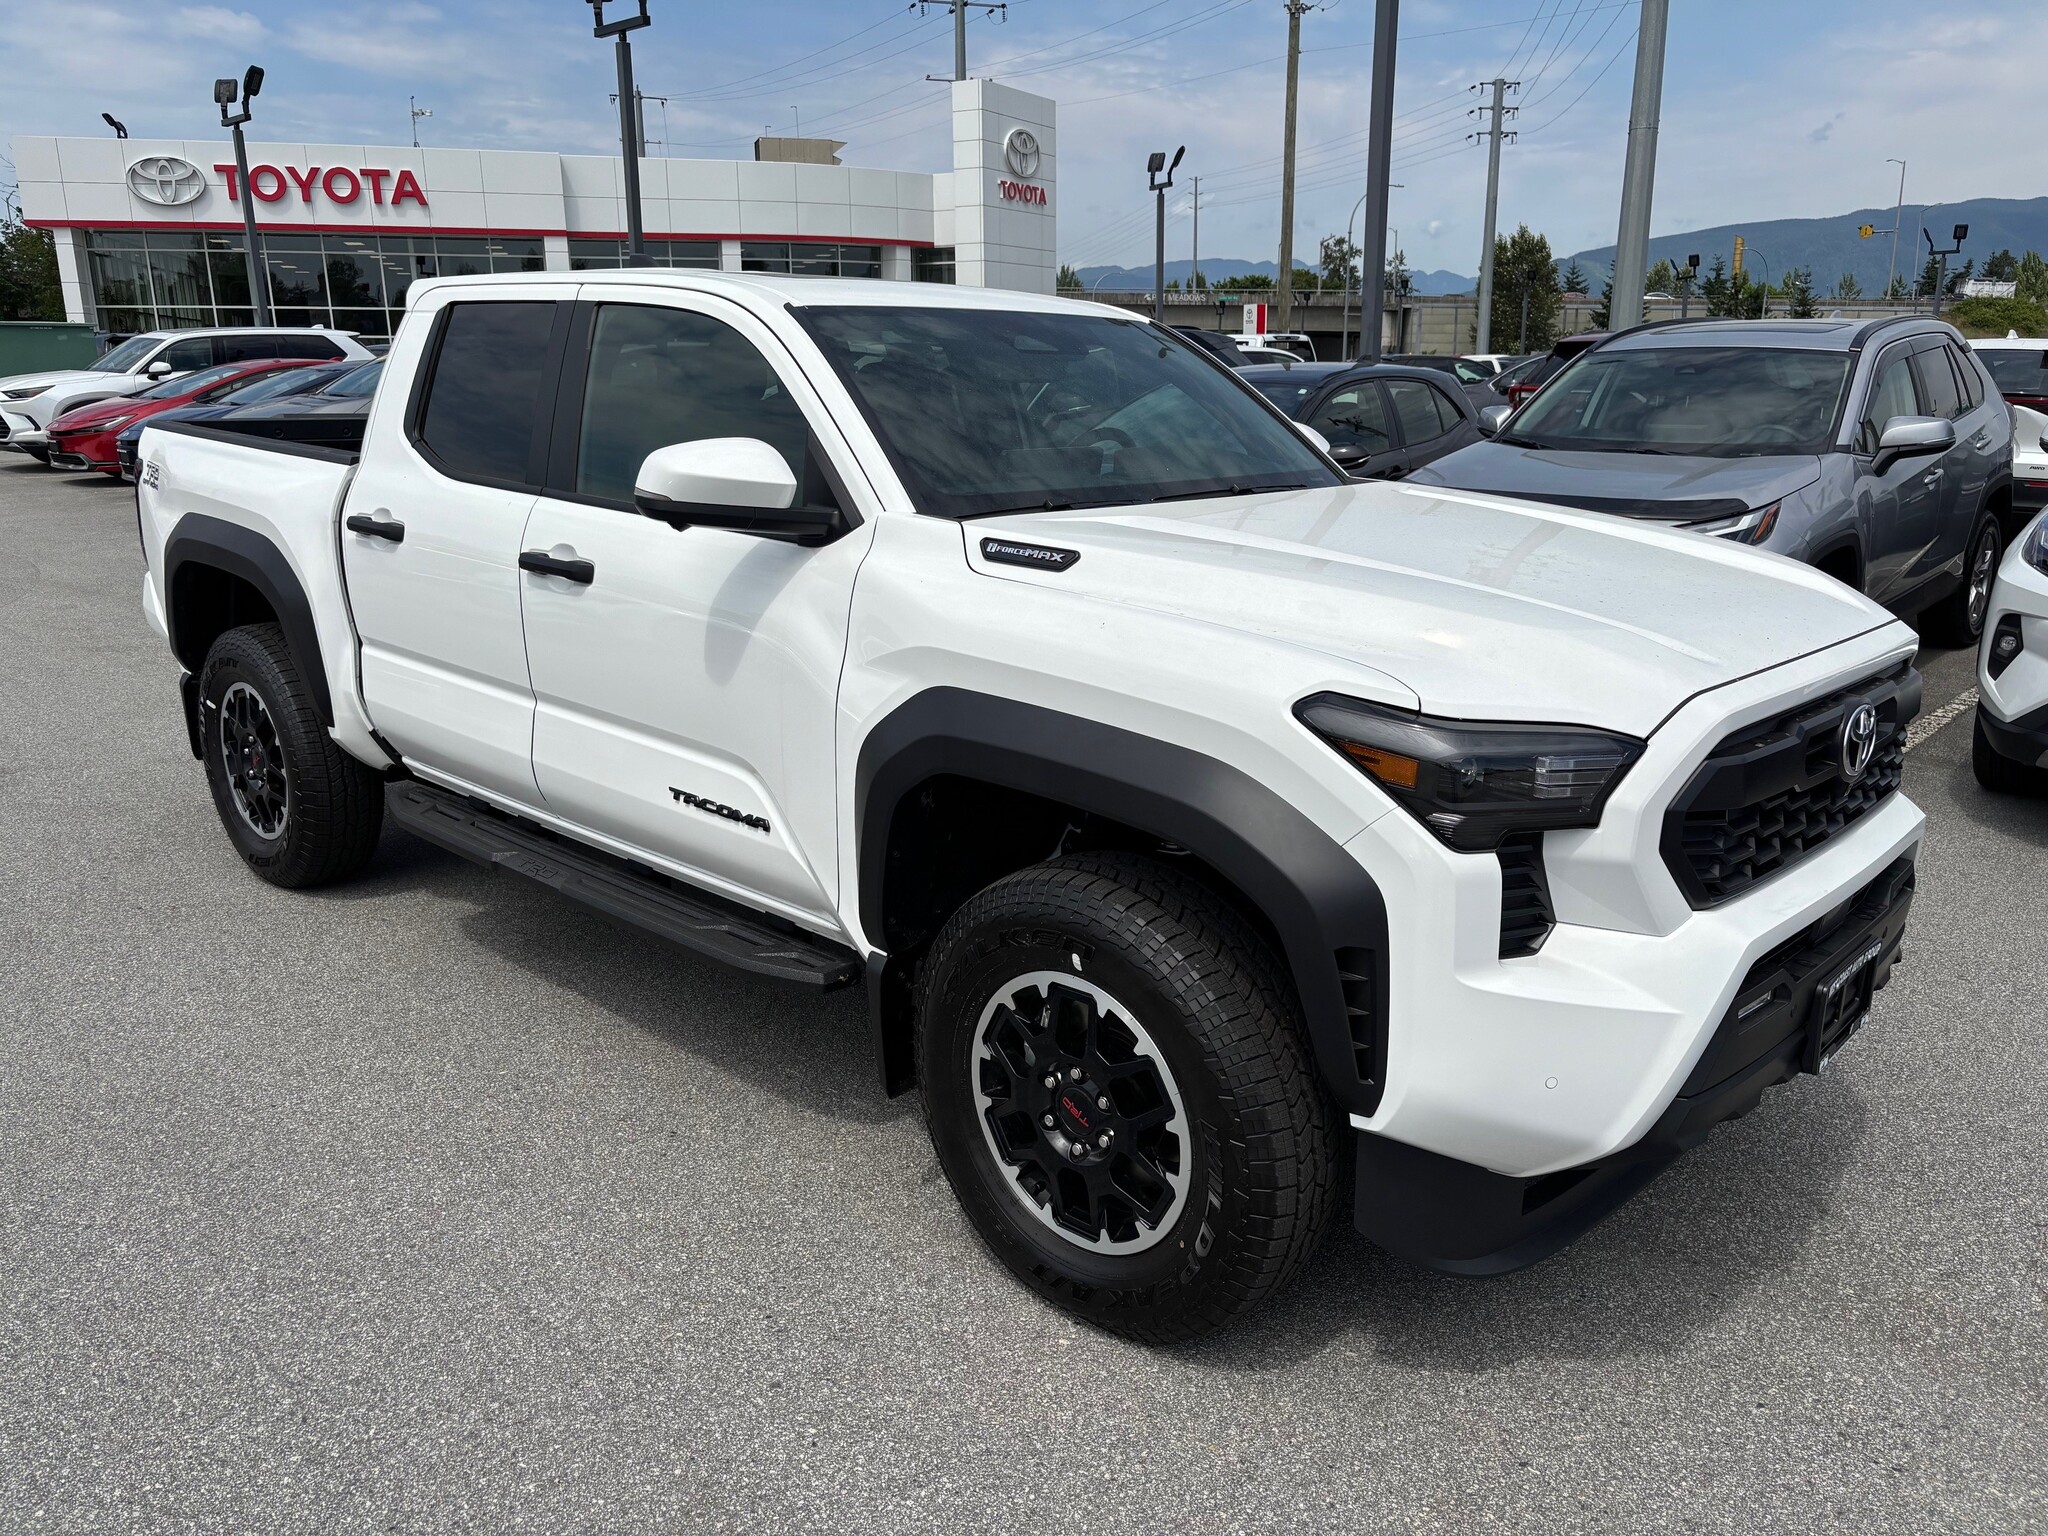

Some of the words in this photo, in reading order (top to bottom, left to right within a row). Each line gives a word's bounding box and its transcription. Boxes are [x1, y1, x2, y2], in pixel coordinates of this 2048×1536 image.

[213, 163, 428, 206] TOYOTA
[999, 179, 1048, 206] TOYOTA
[1168, 293, 1206, 302] MEADOWS
[668, 786, 771, 833] TACOMA
[1062, 1096, 1089, 1128] TRD
